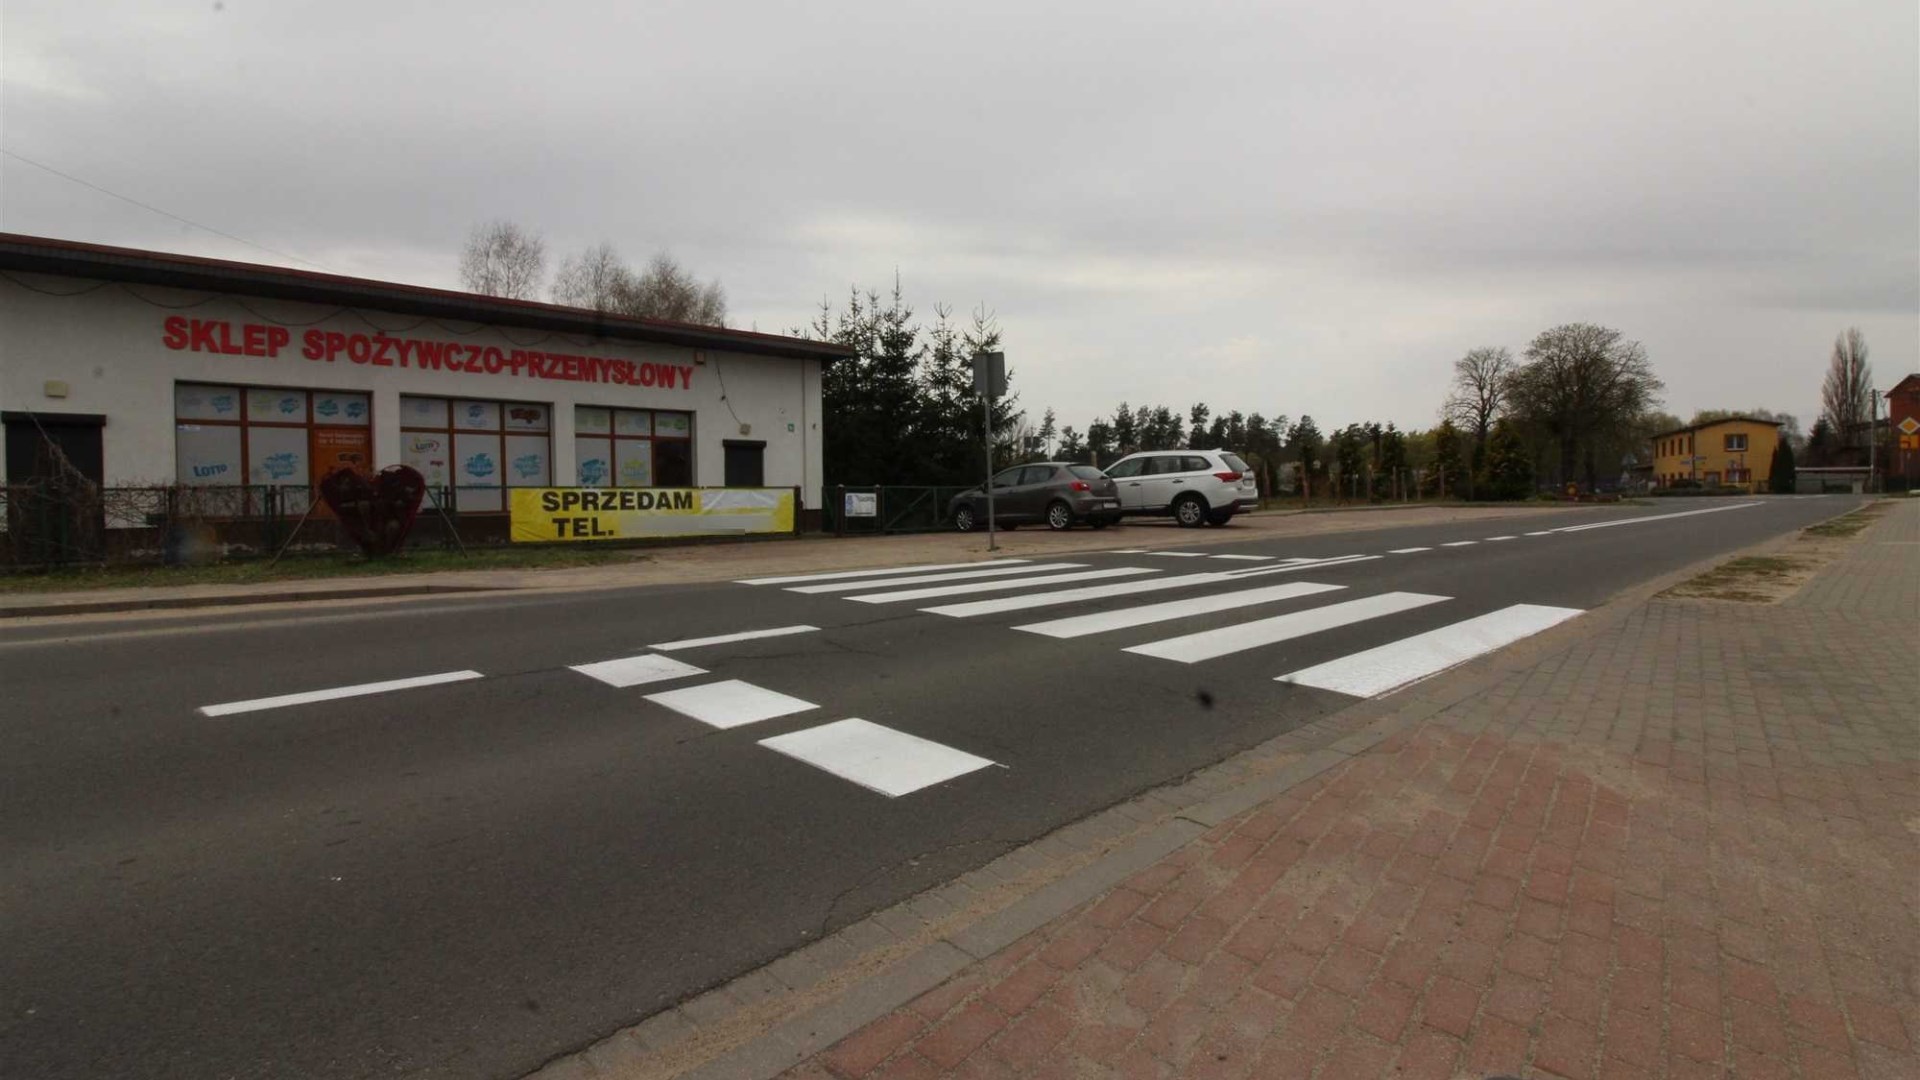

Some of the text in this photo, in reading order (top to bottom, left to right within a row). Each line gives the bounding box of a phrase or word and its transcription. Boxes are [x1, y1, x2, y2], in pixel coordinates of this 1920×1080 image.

[163, 316, 693, 390] SKLEP SPOŻYWCZO-PRZEMYSŁOWY
[193, 463, 228, 477] LOTTO
[542, 491, 693, 512] SPRZEDAM
[552, 517, 615, 538] TEL.
